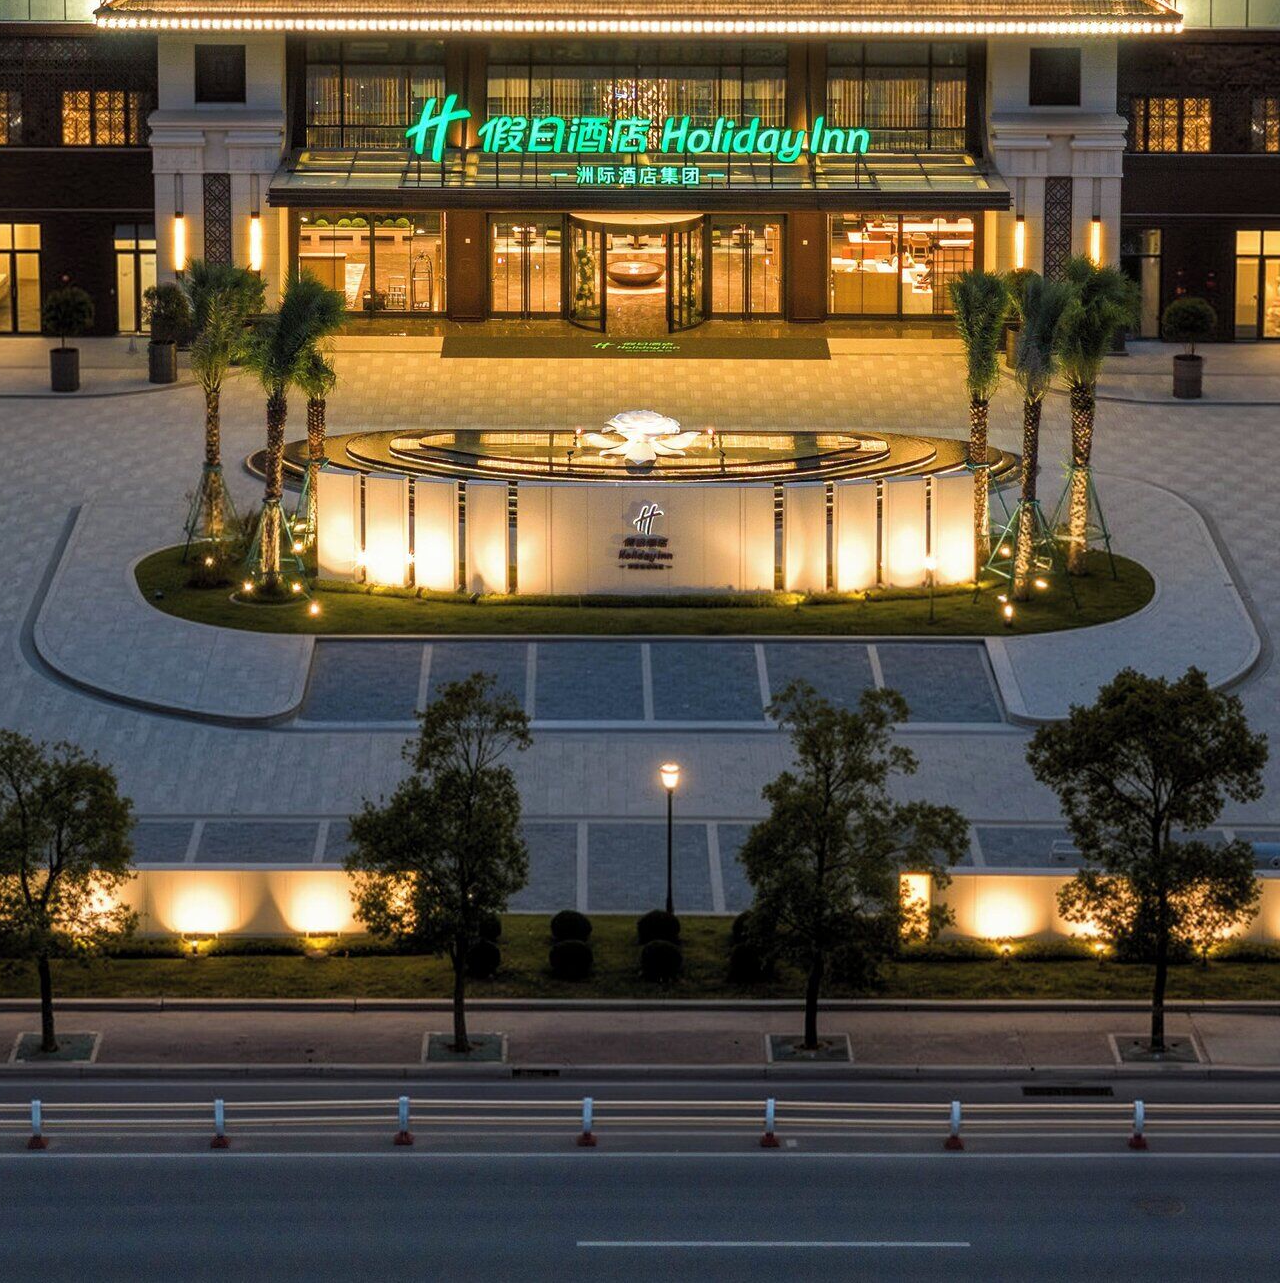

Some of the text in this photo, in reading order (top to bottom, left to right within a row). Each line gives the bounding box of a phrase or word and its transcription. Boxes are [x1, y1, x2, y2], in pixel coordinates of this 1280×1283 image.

[477, 115, 652, 154] 假日酒店
[660, 115, 870, 163] Holiday Inn
[576, 166, 700, 185] 洲际酒店集团
